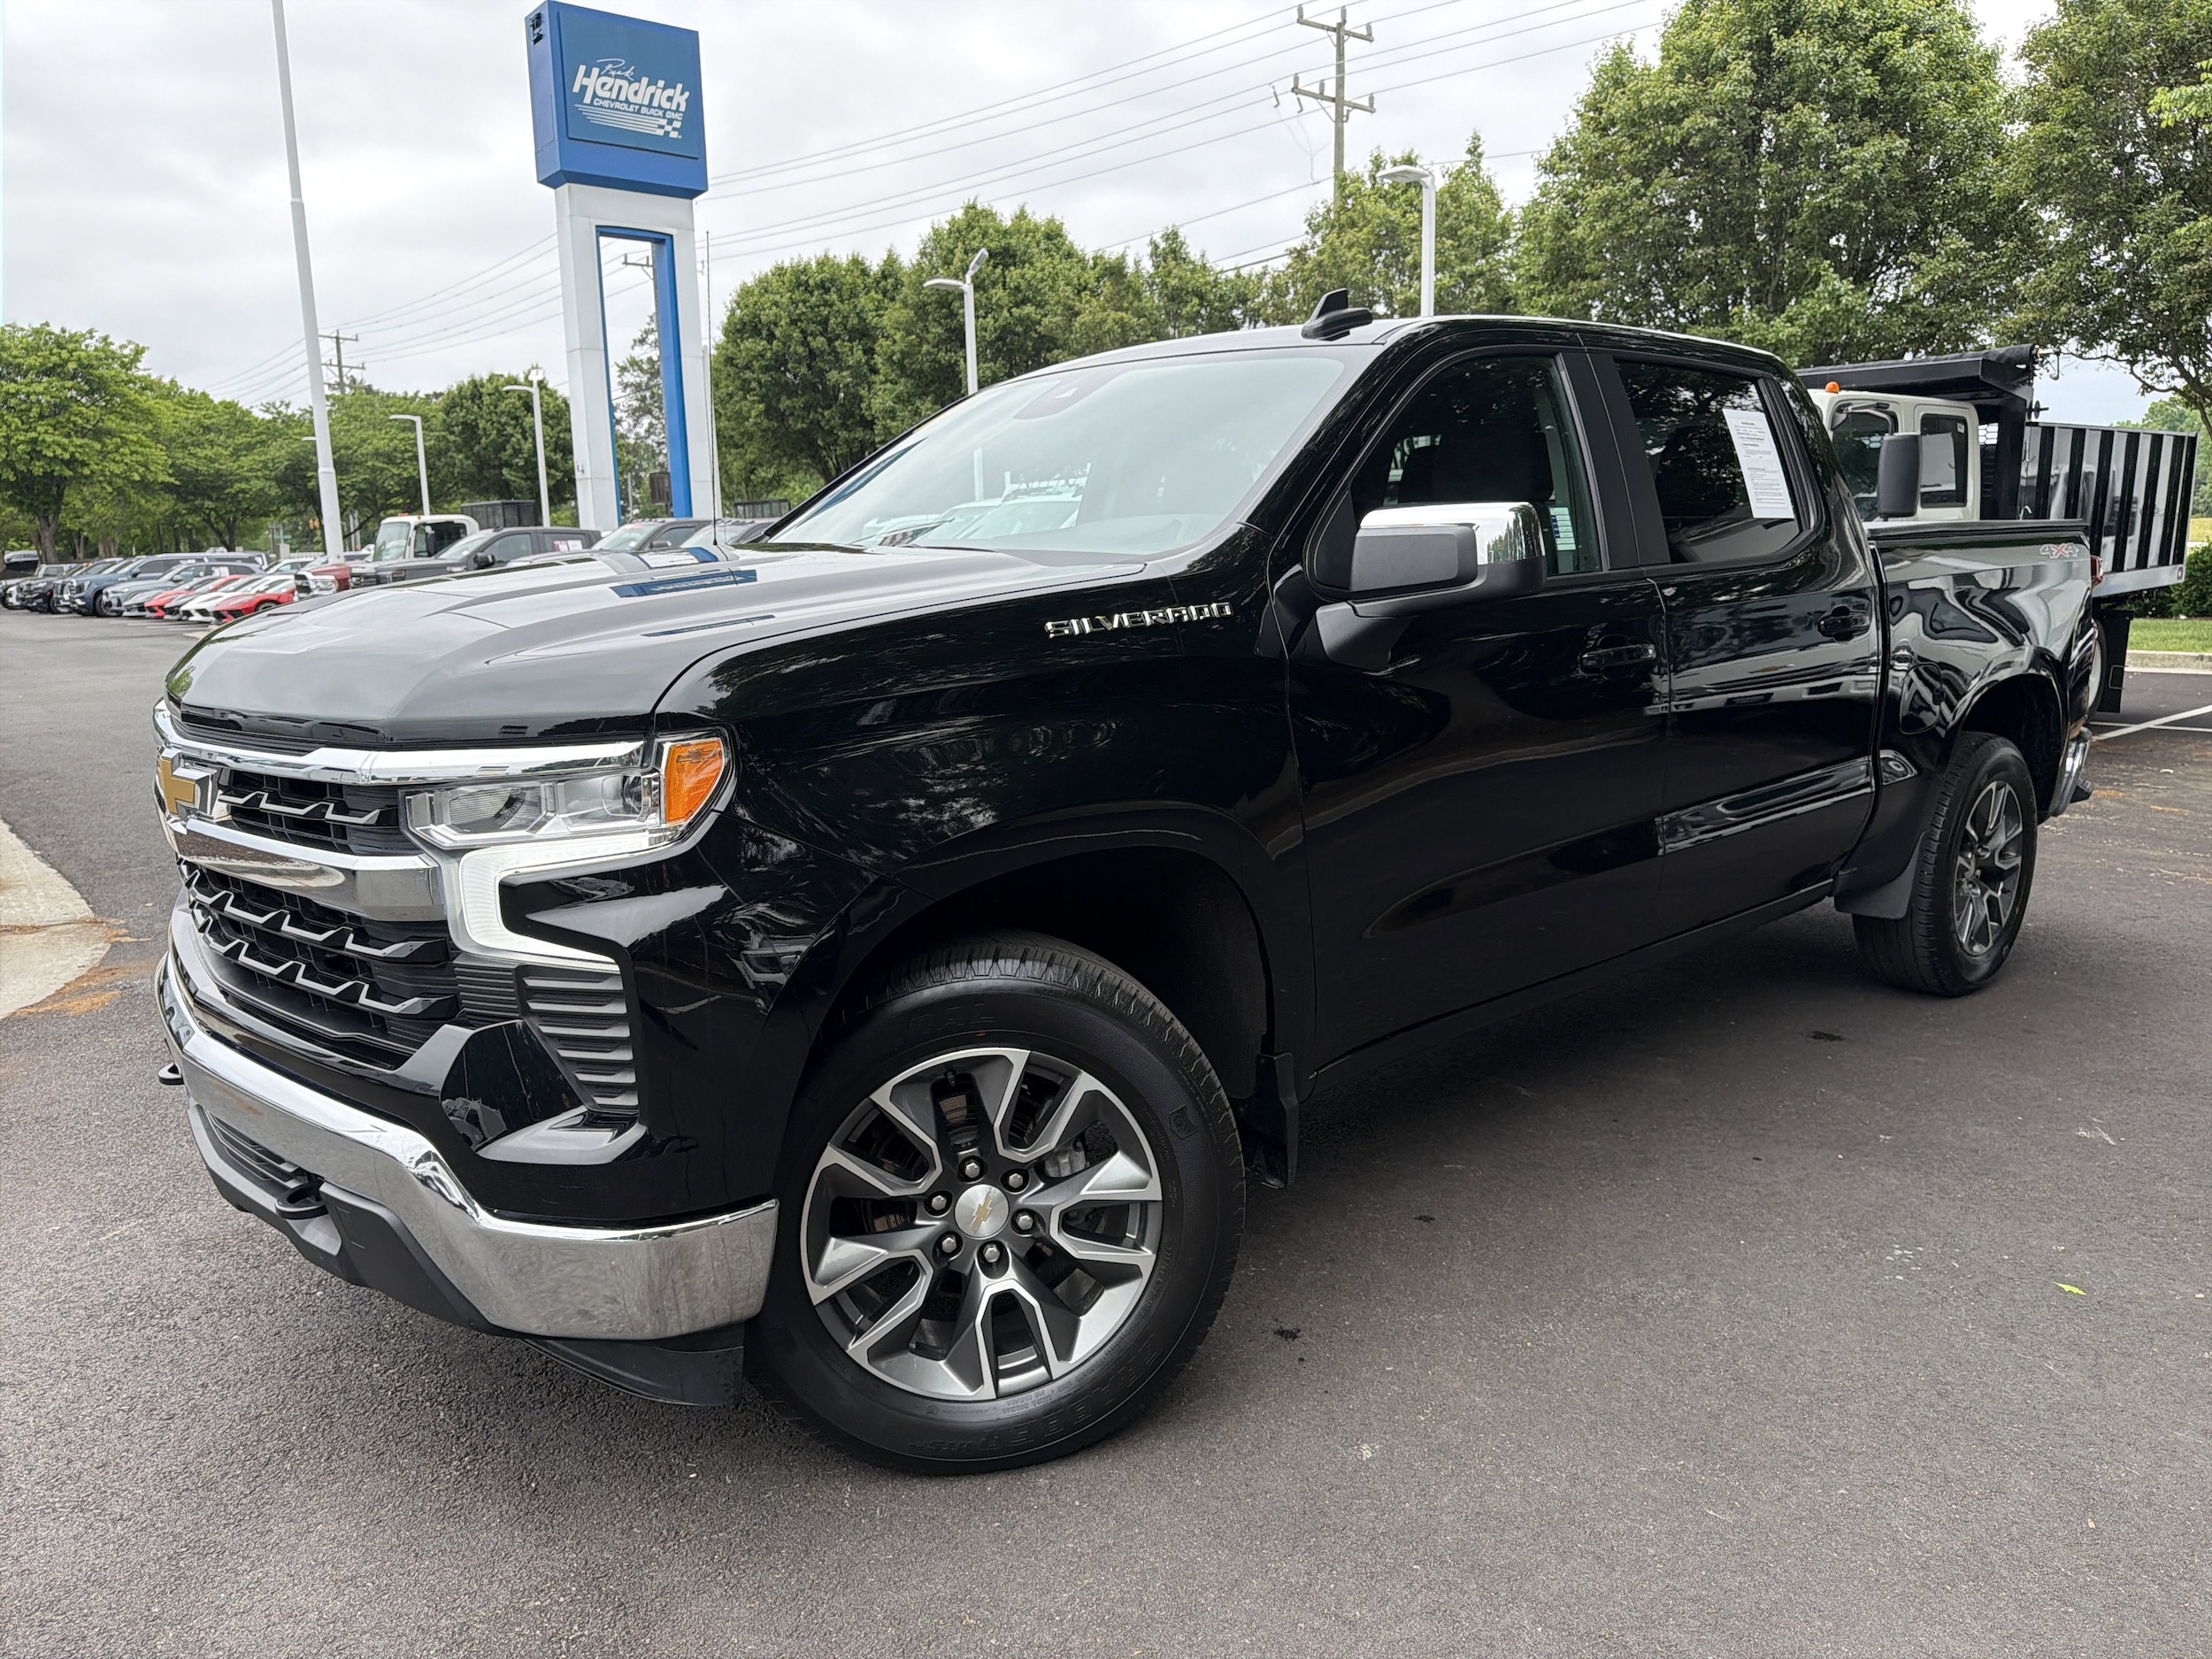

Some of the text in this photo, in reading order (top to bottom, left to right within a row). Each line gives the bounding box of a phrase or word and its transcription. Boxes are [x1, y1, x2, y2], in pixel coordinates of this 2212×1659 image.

[572, 64, 690, 112] Hendrick
[593, 97, 684, 121] CHEVROLET BUICK GMC
[1043, 602, 1235, 639] SILVERADO
